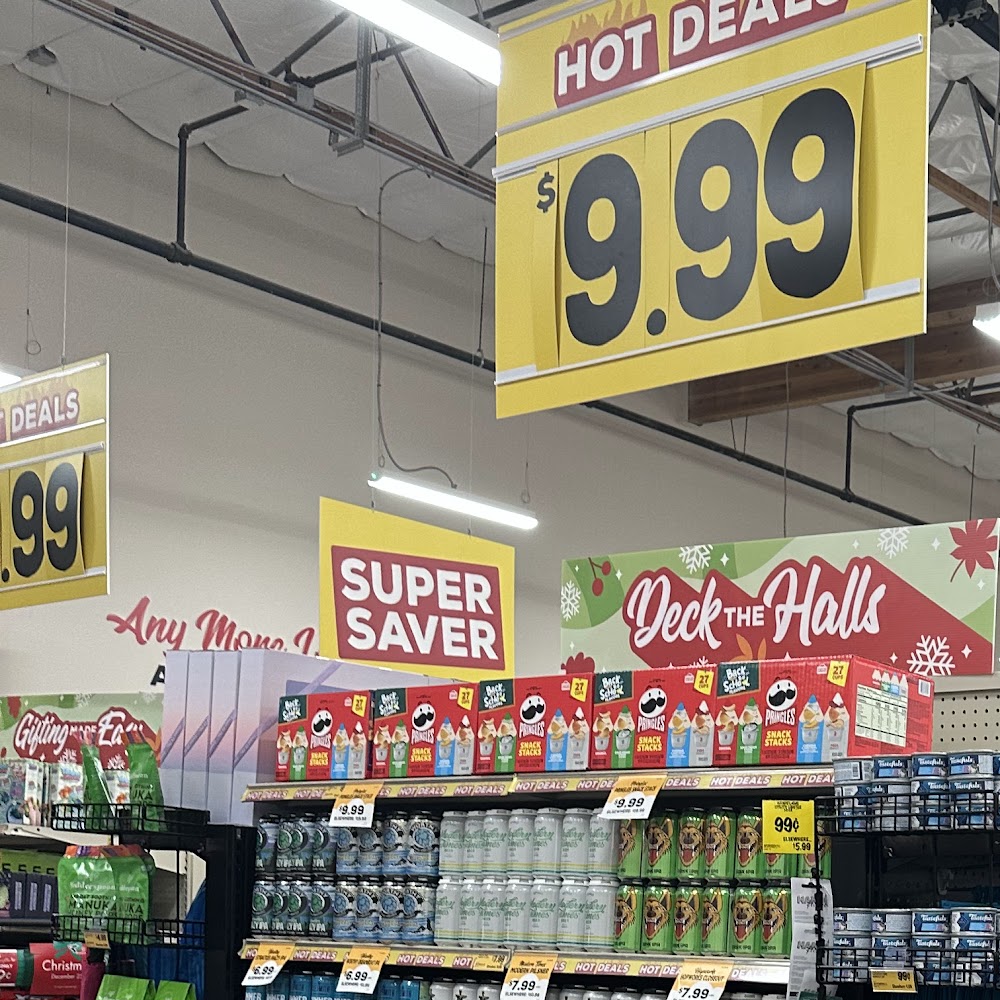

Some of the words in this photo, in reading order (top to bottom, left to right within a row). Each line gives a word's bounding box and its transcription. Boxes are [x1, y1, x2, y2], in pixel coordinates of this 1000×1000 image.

[558, 20, 652, 96] HOT
[673, 0, 842, 56] DEAL
[536, 87, 857, 347] $9.99
[12, 391, 79, 434] DEALS
[341, 556, 493, 615] SUPER
[628, 573, 723, 650] Deck
[723, 605, 764, 629] THE
[763, 563, 887, 647] Halls
[106, 596, 187, 651] Any
[345, 607, 499, 661] SAVER
[832, 666, 844, 676] 27
[700, 675, 710, 684] 27
[766, 708, 795, 726] PRINGLES
[638, 717, 666, 732] PRINGLES
[15, 711, 69, 756] Gifting
[98, 709, 144, 746] Ea
[411, 729, 435, 745] PRINGLES
[766, 731, 791, 739] SNACK
[639, 736, 661, 744] SNACK
[765, 737, 792, 746] STACKS
[412, 747, 432, 756] SNACK
[518, 748, 542, 757] STACKS
[637, 743, 662, 751] STACKS
[614, 797, 645, 809] $9.99
[339, 804, 365, 815] $9.99
[774, 816, 800, 834] 99¢
[42, 959, 83, 972] Christm
[252, 965, 275, 976] $6.99
[576, 962, 596, 972] HOT
[597, 963, 629, 973] DEALS
[343, 970, 368, 981] $6.99
[509, 980, 536, 991] $7.99
[678, 987, 709, 999] $7.99
